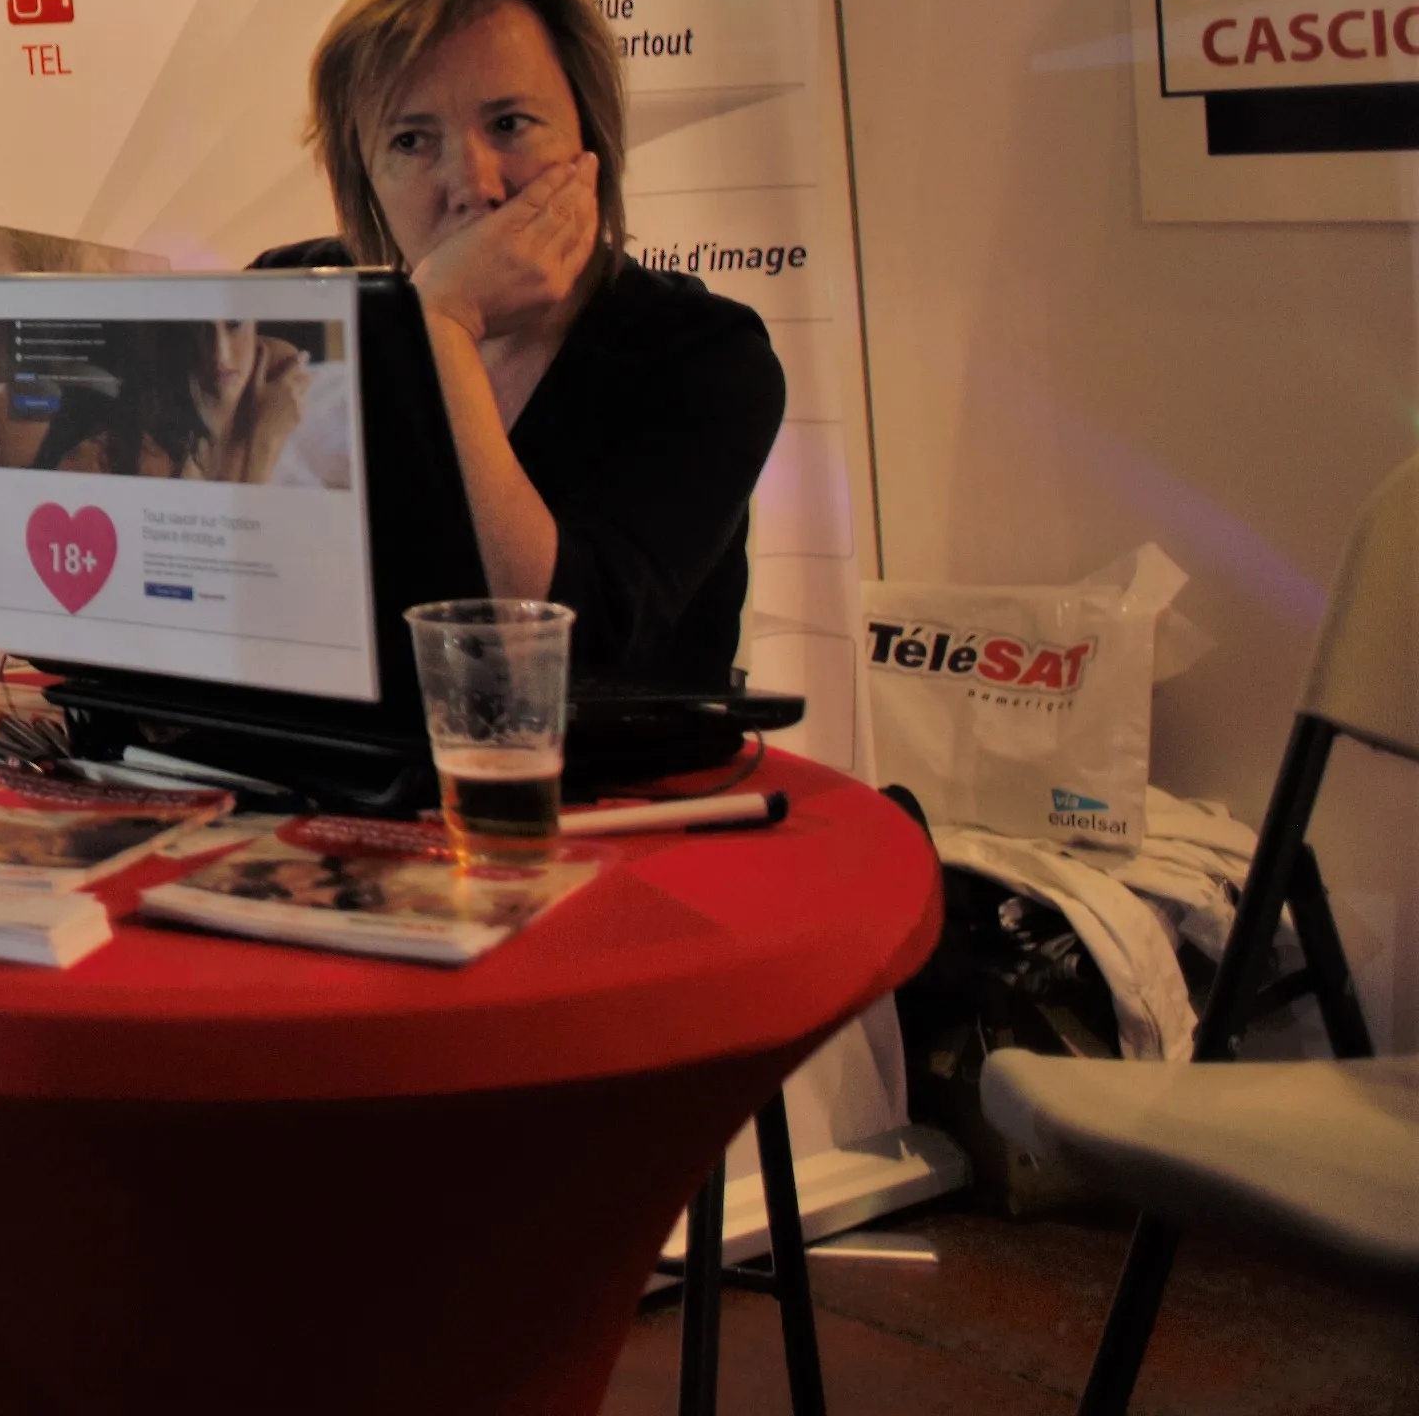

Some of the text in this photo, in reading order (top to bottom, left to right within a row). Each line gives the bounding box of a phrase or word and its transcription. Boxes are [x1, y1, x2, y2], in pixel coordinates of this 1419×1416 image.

[21, 44, 72, 76] TEL
[687, 242, 807, 277] d'image
[48, 542, 98, 576] 18+
[868, 621, 1091, 691] TéléSAT
[1048, 810, 1128, 835] eutelsat
